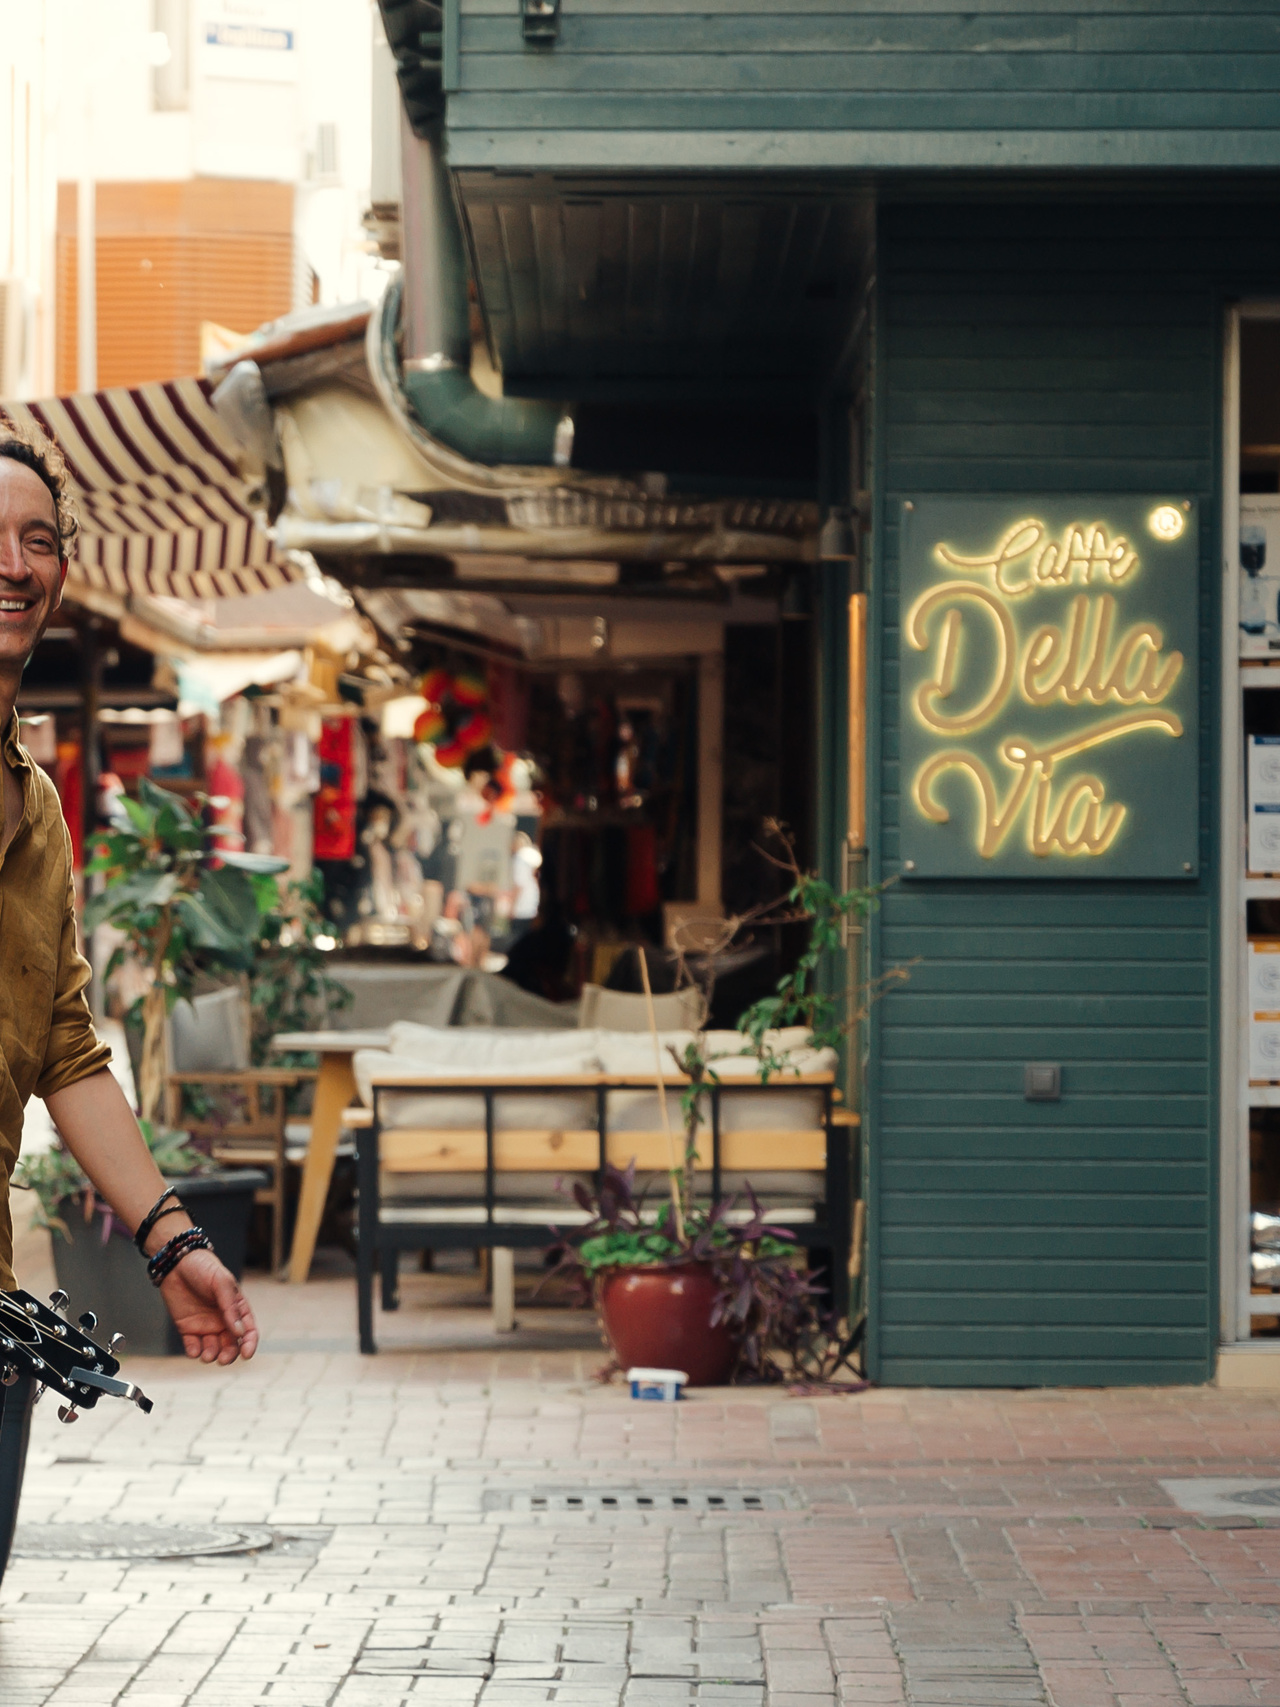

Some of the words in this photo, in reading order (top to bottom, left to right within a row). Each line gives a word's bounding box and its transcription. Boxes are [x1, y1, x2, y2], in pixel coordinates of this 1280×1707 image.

[935, 520, 1138, 595] Caffe
[909, 582, 1182, 733] Della
[915, 711, 1182, 857] Via
